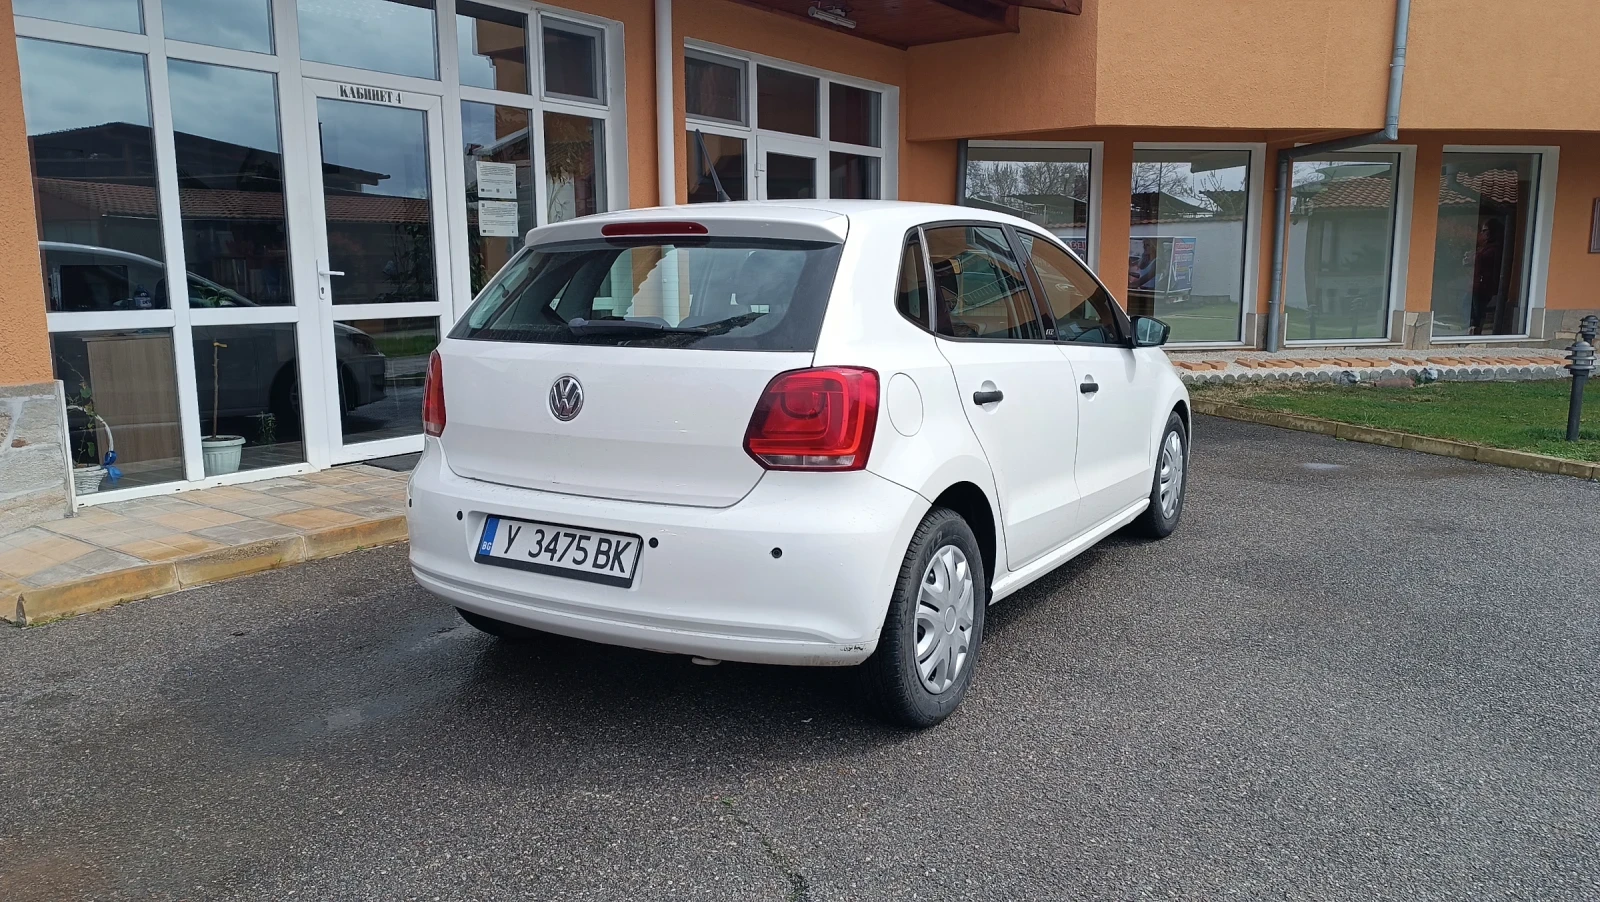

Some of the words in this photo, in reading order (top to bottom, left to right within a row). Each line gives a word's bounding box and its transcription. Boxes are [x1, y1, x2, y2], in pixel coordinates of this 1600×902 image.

[340, 85, 393, 102] КАБИНЕТ
[395, 92, 402, 104] 4
[481, 541, 492, 550] BG
[527, 528, 592, 566] 3475
